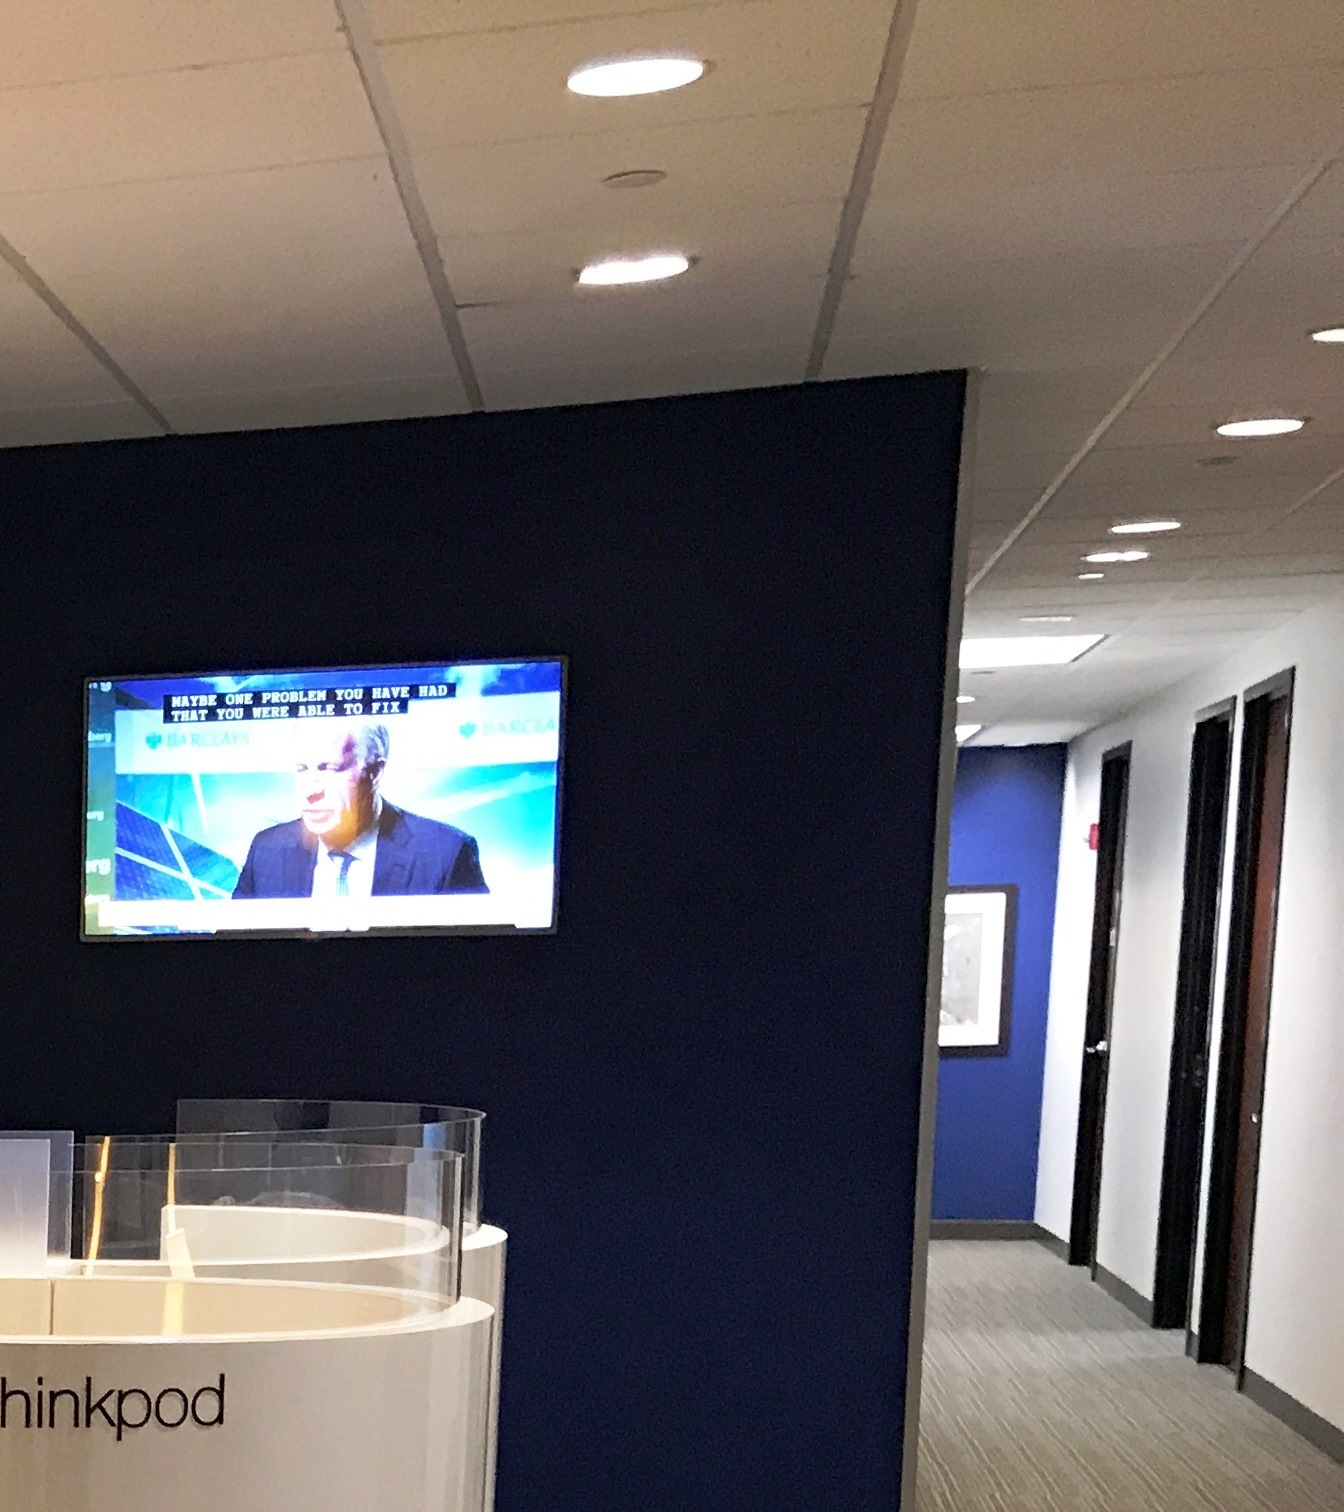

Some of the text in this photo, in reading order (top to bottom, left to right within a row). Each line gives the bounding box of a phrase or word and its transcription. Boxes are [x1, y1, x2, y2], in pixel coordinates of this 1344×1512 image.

[171, 684, 448, 708] MAYBE ONE PROBLEM YOU HAVE HAD
[171, 701, 400, 722] THAT YOU WERE ABLE TO FIX
